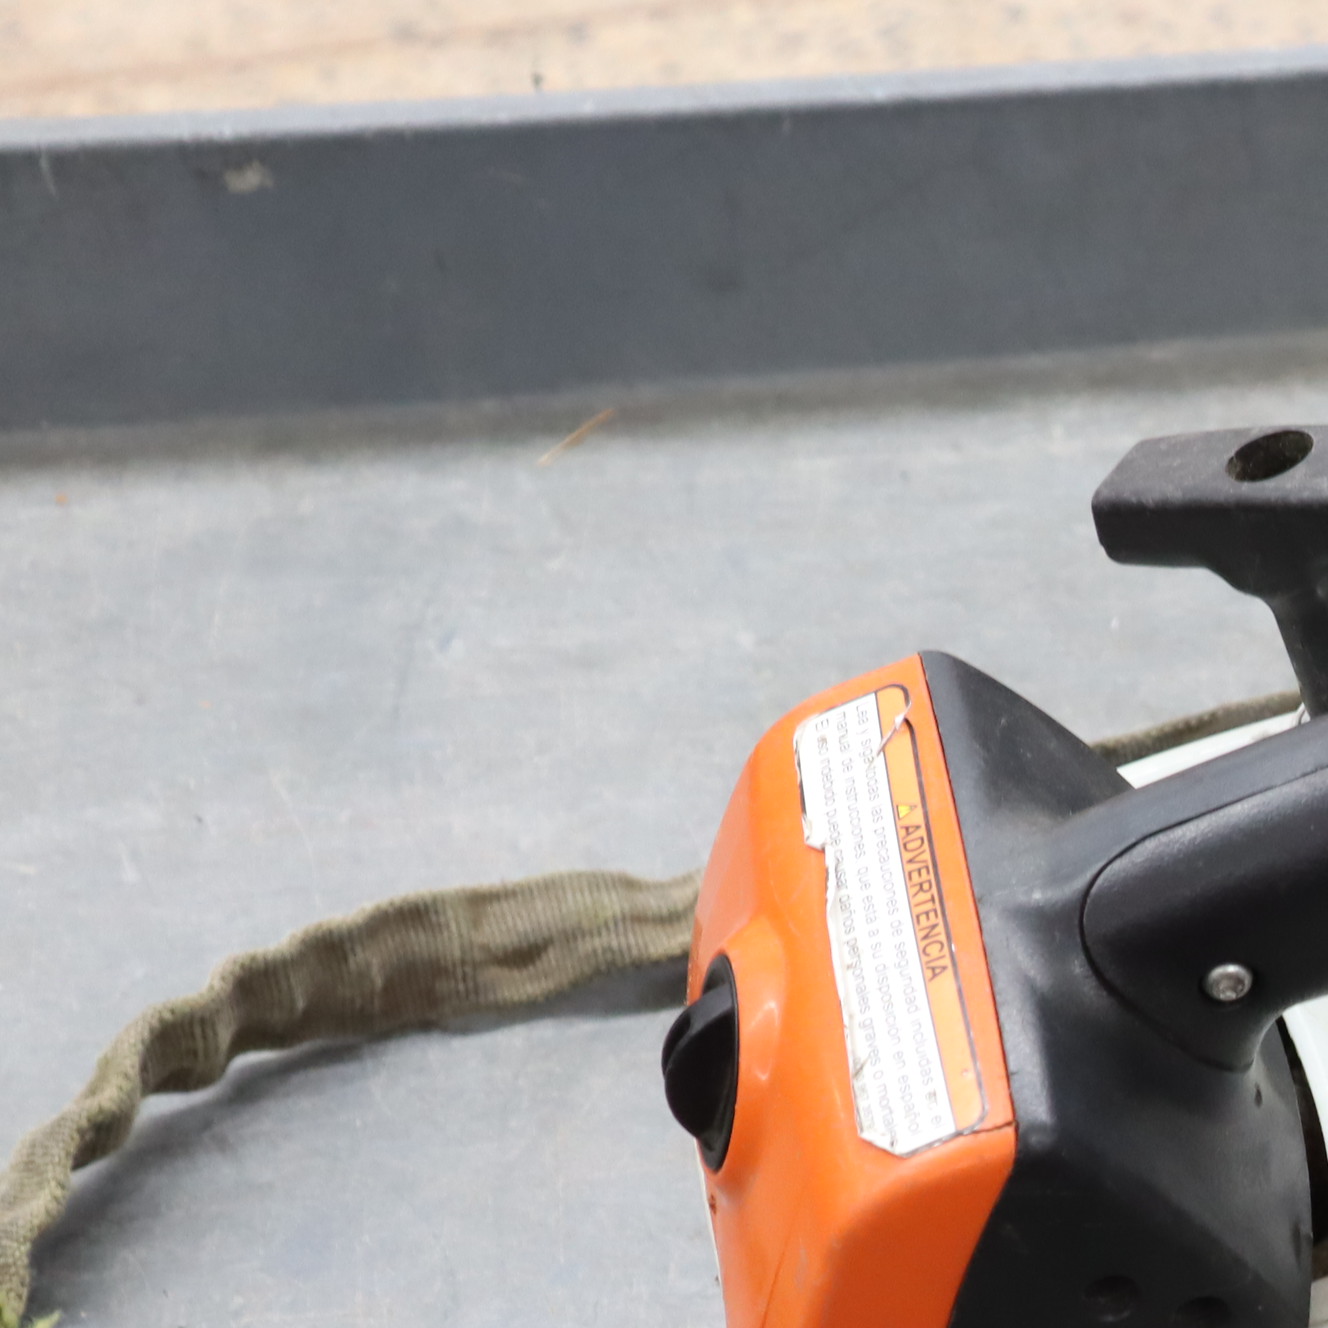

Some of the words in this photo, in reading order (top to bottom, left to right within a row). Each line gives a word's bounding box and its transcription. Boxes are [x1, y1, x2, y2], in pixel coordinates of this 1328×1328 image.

[852, 864, 871, 894] que
[897, 818, 951, 983] ADVERTENCIA
[889, 916, 906, 939] de
